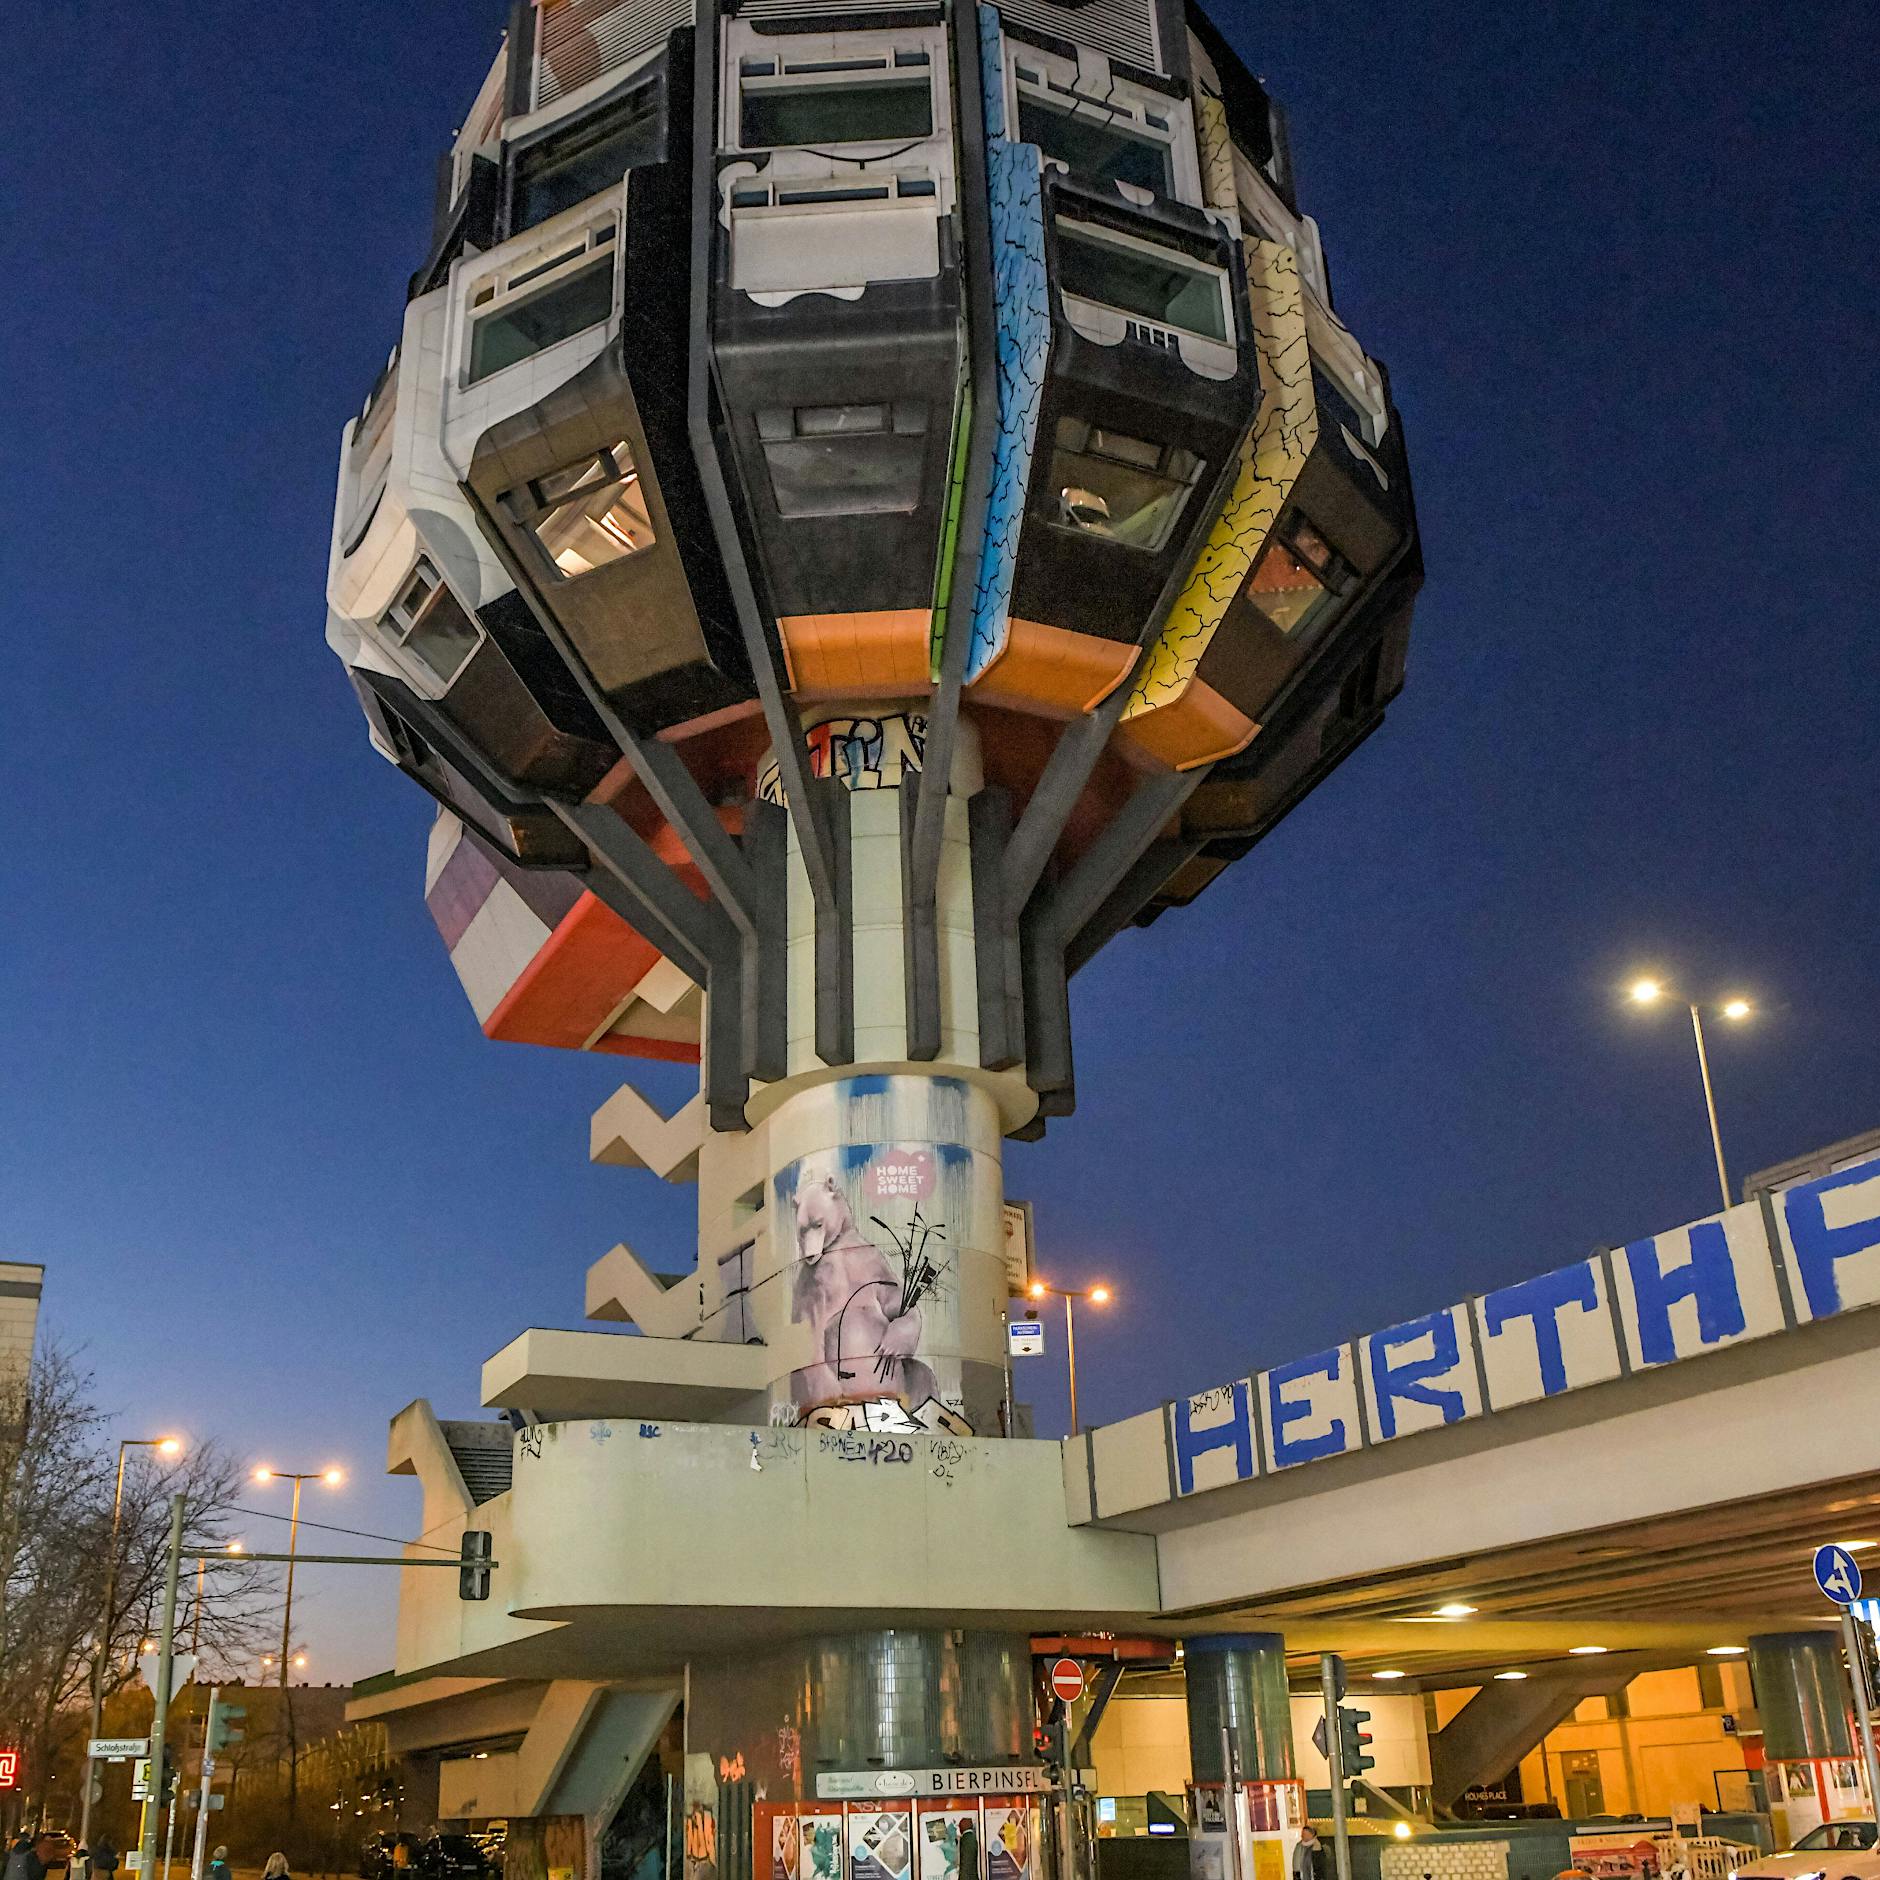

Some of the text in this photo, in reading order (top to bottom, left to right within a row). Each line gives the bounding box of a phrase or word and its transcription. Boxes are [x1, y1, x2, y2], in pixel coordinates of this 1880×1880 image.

[876, 1165, 918, 1176] HOME
[878, 1175, 924, 1185] SWEET
[877, 1185, 918, 1195] HOME
[932, 1765, 1038, 1791] BIERPINSEL
